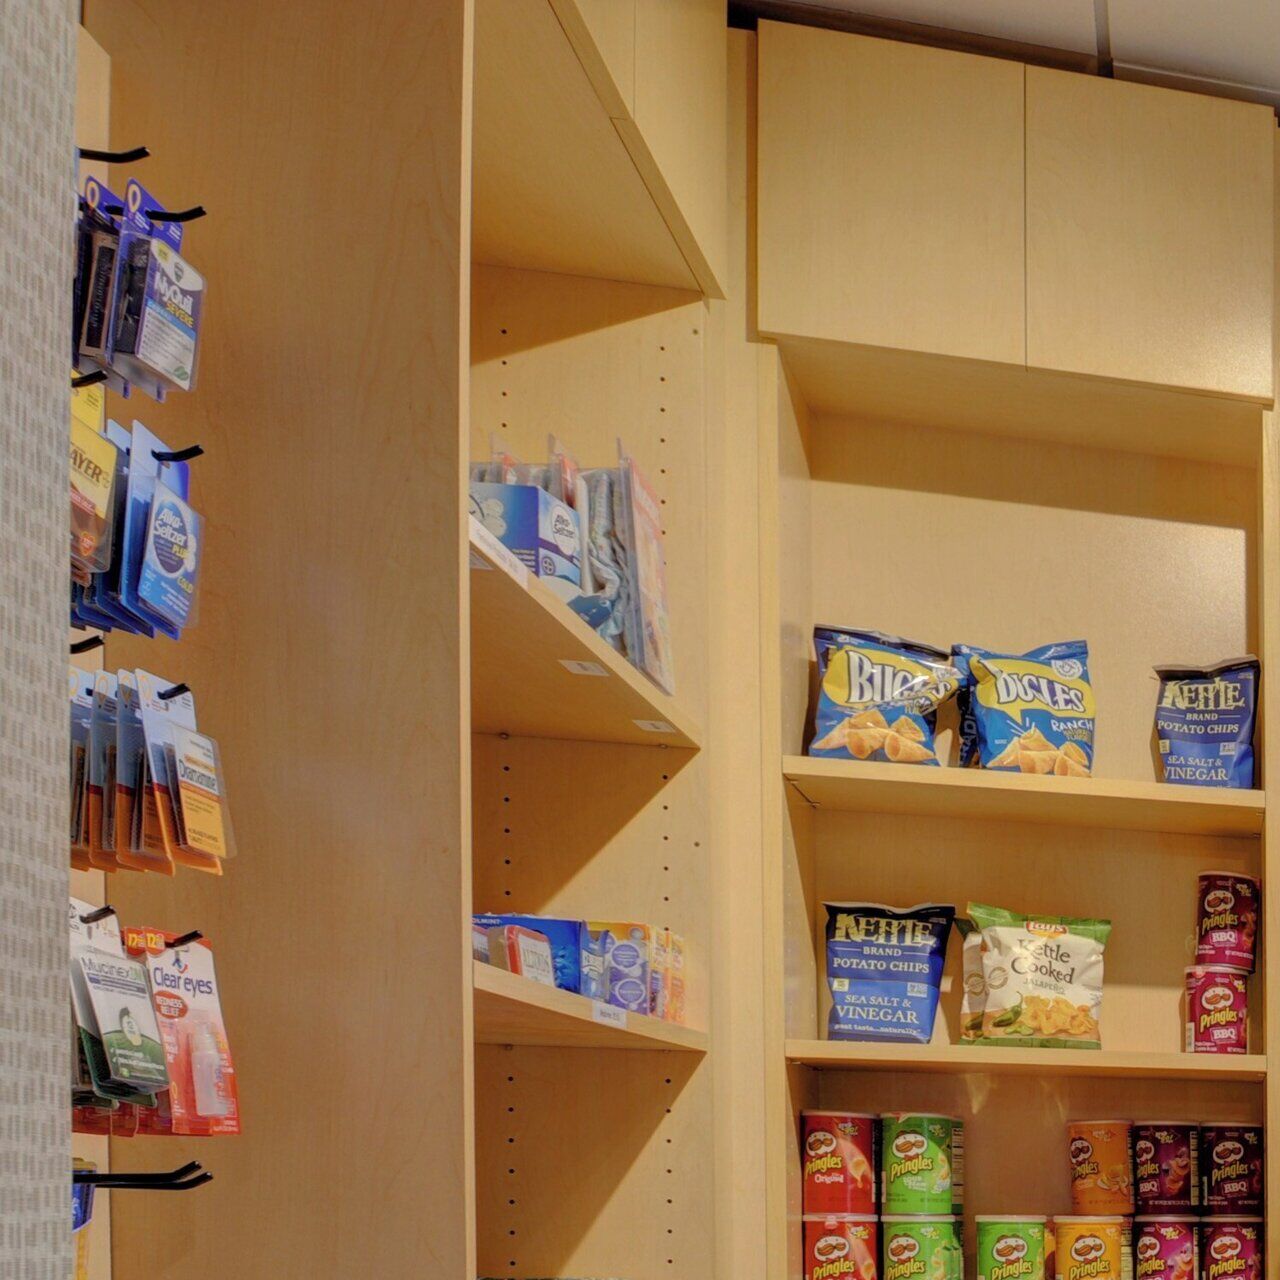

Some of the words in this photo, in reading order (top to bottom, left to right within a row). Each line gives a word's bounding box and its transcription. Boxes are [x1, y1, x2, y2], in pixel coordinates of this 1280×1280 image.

[154, 271, 194, 315] NyQuil
[166, 300, 195, 328] SEVERE
[153, 520, 187, 546] Seltzer
[1164, 677, 1245, 710] KETTLE
[1051, 718, 1094, 733] RANCH
[1158, 719, 1204, 734] POTATO
[1207, 723, 1240, 734] CHIPS
[1185, 712, 1219, 722] BRAND
[1167, 756, 1187, 767] SEA
[1189, 757, 1214, 768] SALT
[1215, 758, 1223, 768] &
[178, 757, 218, 793] Dramamine
[1163, 766, 1229, 782] VINEGAR
[834, 914, 936, 948] KETTLE
[1201, 910, 1240, 932] Pringles
[1211, 931, 1237, 944] BBQ
[862, 947, 902, 957] BRAND
[1017, 936, 1071, 965] Kettle
[833, 957, 888, 972] POTATO
[890, 961, 930, 974] CHIPS
[1010, 957, 1076, 987] Cooked
[154, 966, 181, 990] Clear
[184, 976, 213, 998] eyes
[844, 994, 866, 1007] SEA
[869, 995, 900, 1009] SALT
[902, 998, 912, 1009] &
[835, 1007, 920, 1025] VINEGAR
[1199, 1005, 1239, 1029] Pringles
[1213, 1028, 1236, 1040] BBQ
[805, 1153, 843, 1179] Pringles
[890, 1156, 934, 1182] Pringles
[1211, 1160, 1249, 1186] Pringles
[814, 1172, 845, 1184] Original
[1224, 1181, 1248, 1193] BBQ
